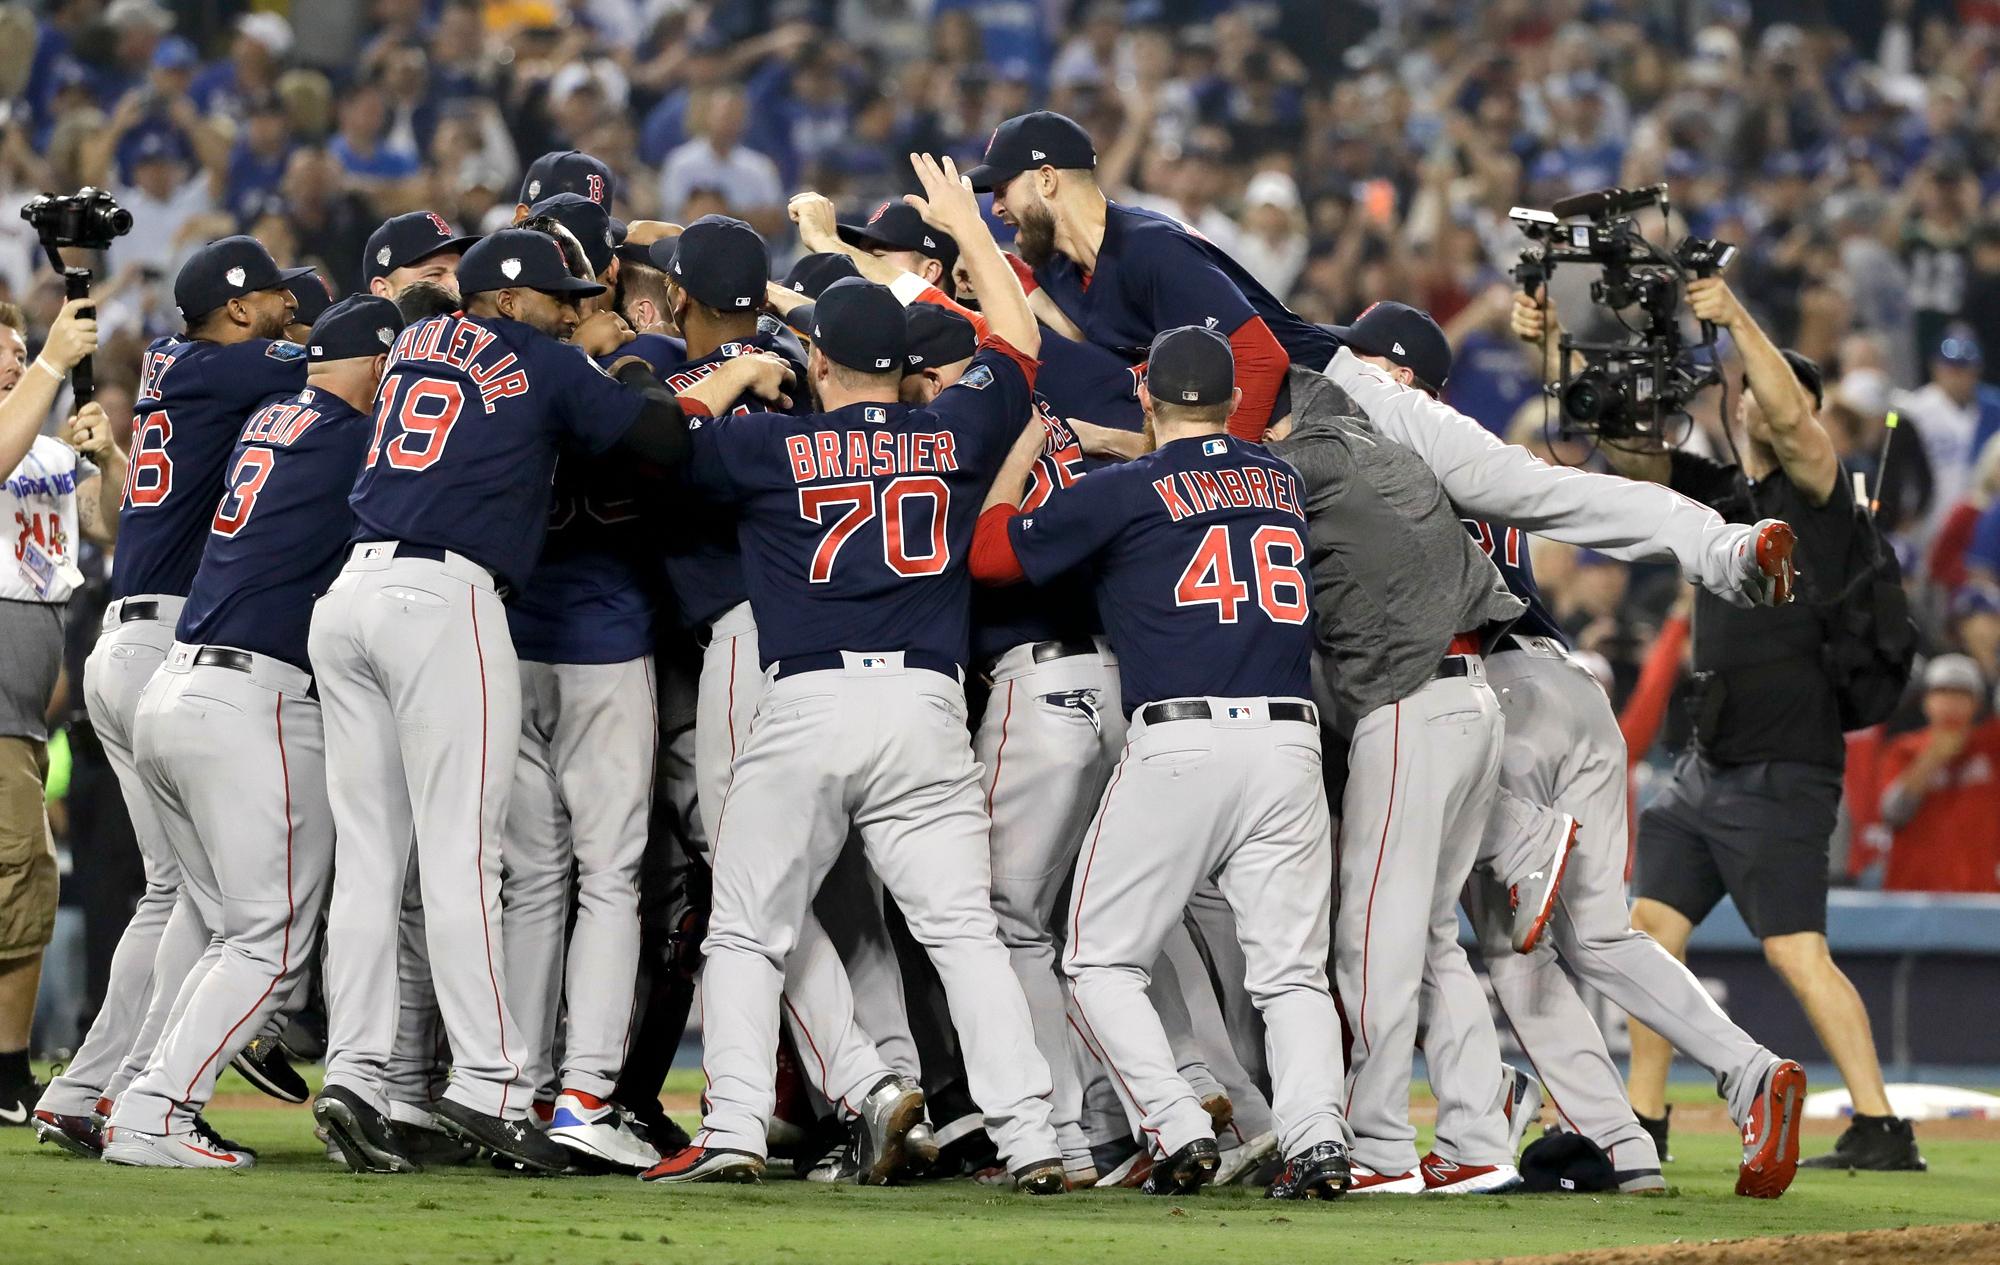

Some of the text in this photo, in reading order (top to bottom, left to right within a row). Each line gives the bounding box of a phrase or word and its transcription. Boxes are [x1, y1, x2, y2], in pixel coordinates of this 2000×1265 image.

[586, 174, 605, 204] B
[469, 351, 530, 415] JR.
[240, 403, 321, 447] LEON
[365, 374, 466, 472] 19
[785, 430, 960, 484] BRASIER
[211, 446, 275, 538] 3
[1152, 466, 1306, 523] KIMBREL
[798, 475, 951, 584] 70
[1174, 524, 1310, 626] 46
